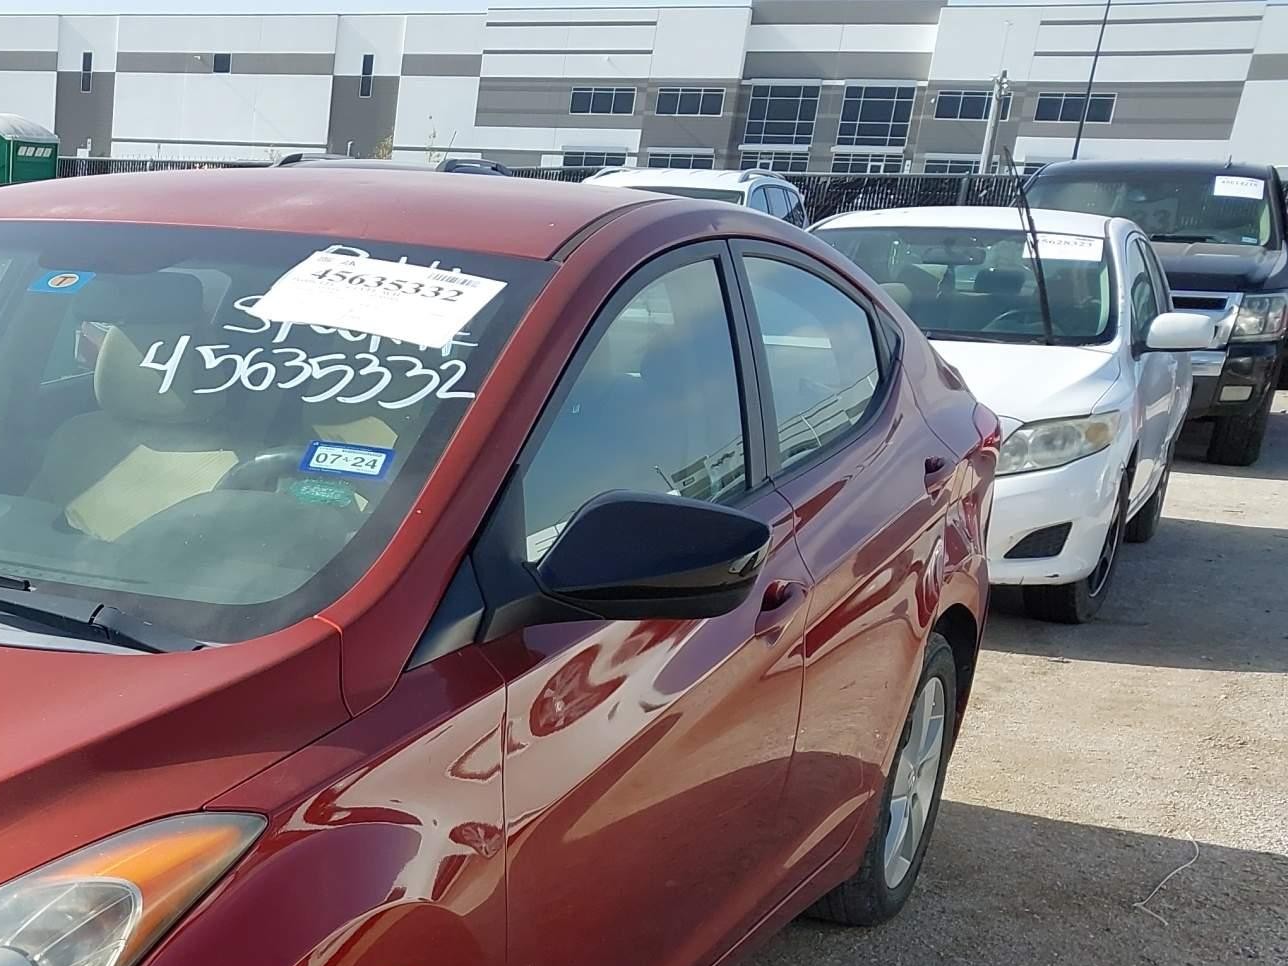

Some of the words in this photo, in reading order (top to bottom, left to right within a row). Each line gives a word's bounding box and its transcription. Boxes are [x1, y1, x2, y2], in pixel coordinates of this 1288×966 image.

[311, 268, 464, 303] 45635332
[140, 335, 476, 410] 45635332
[315, 453, 343, 465] 07
[349, 456, 379, 469] 24
